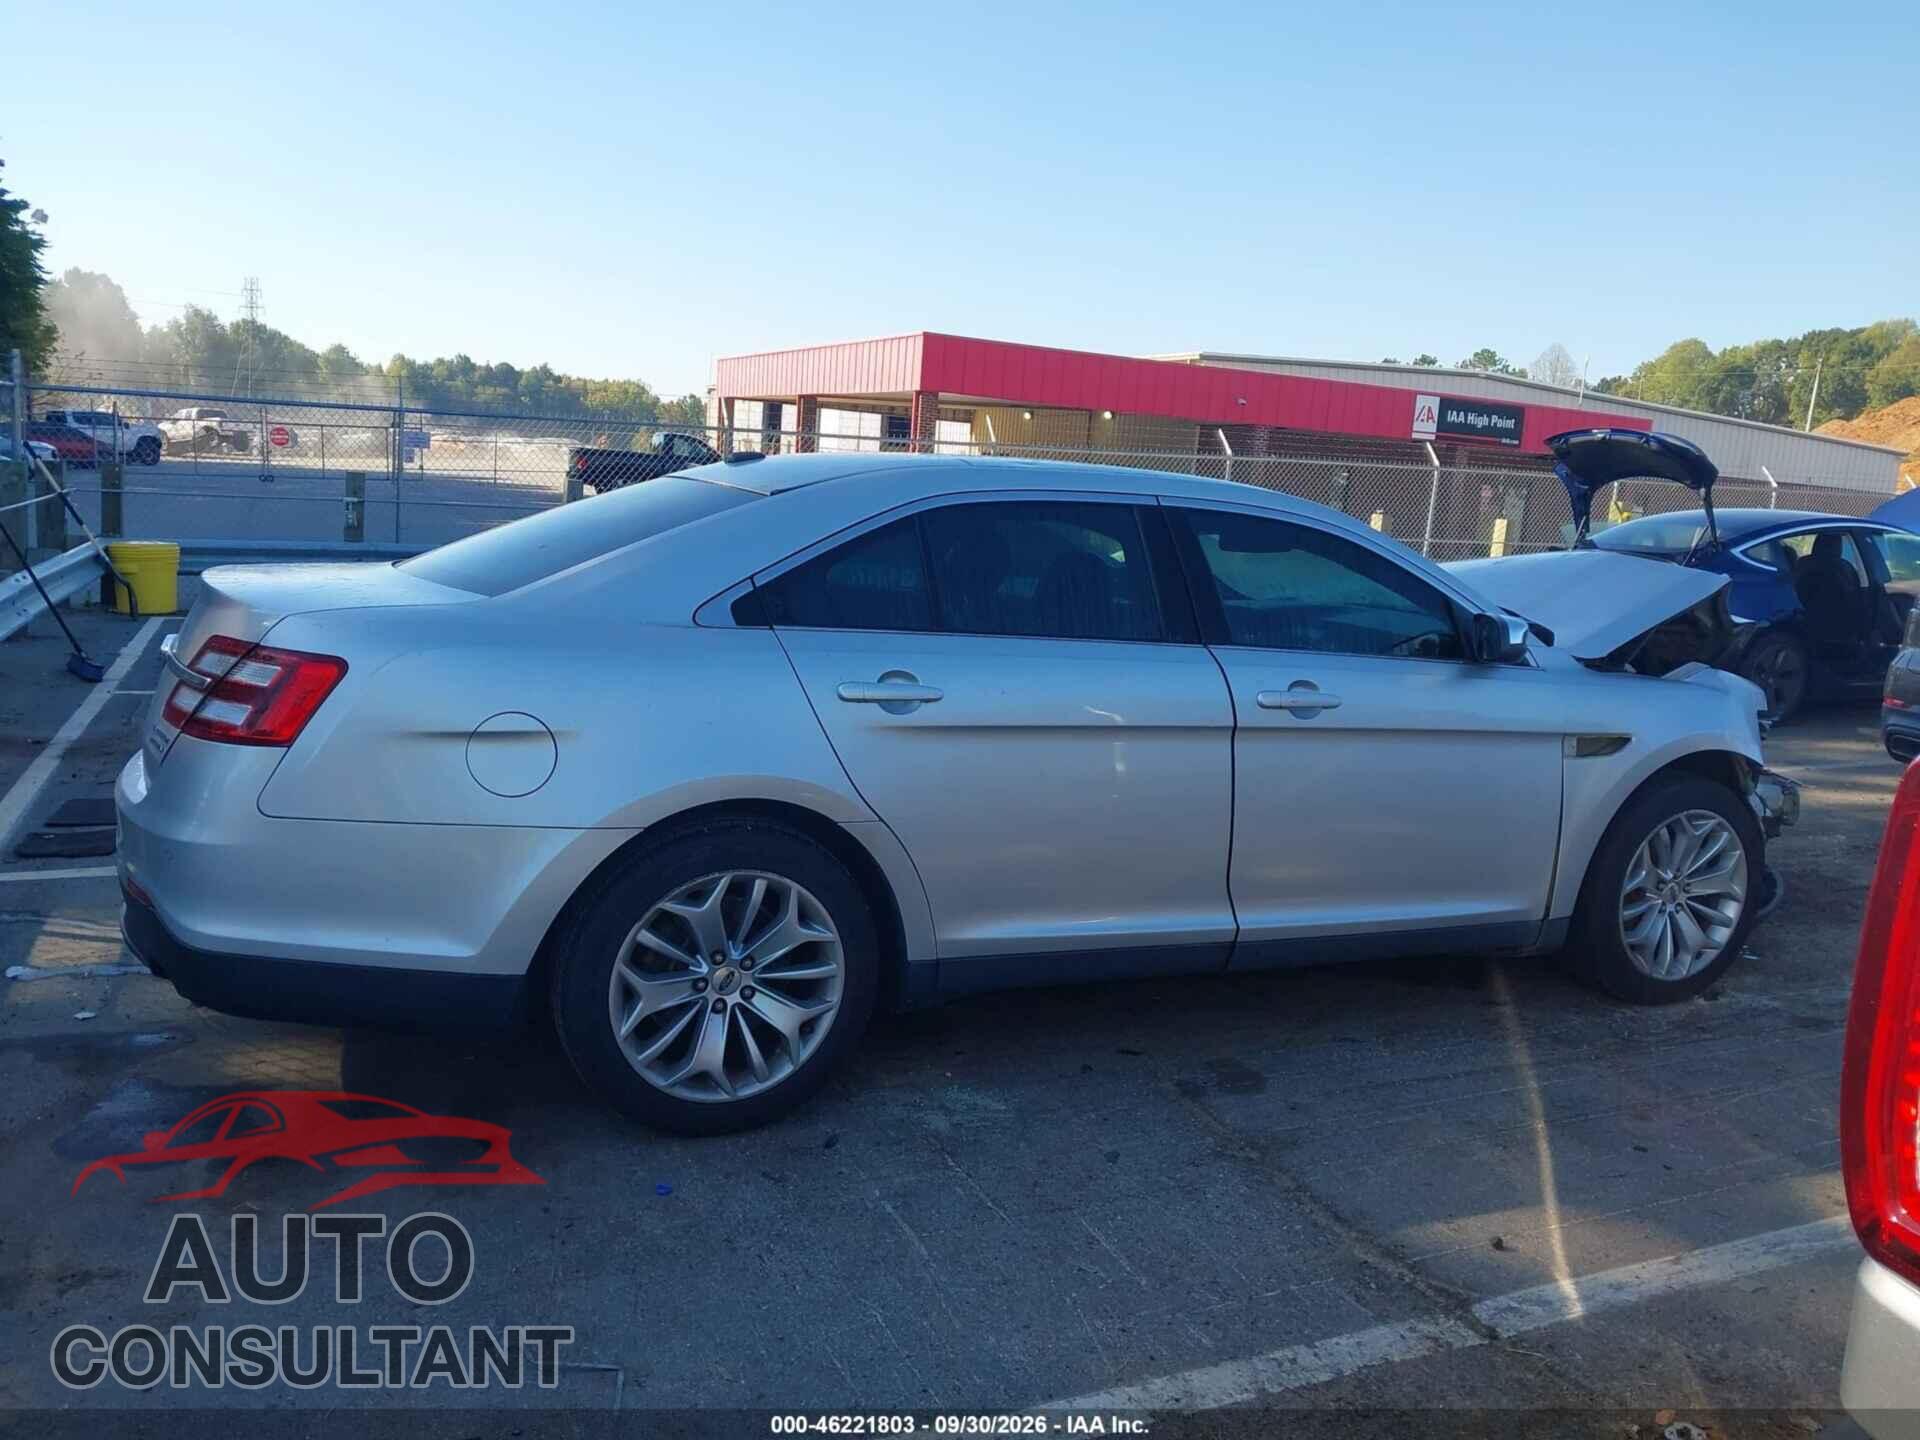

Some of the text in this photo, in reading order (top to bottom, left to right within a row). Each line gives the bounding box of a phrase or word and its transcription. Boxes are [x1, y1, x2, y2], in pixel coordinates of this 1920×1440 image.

[1447, 410, 1516, 429] IAA High Point
